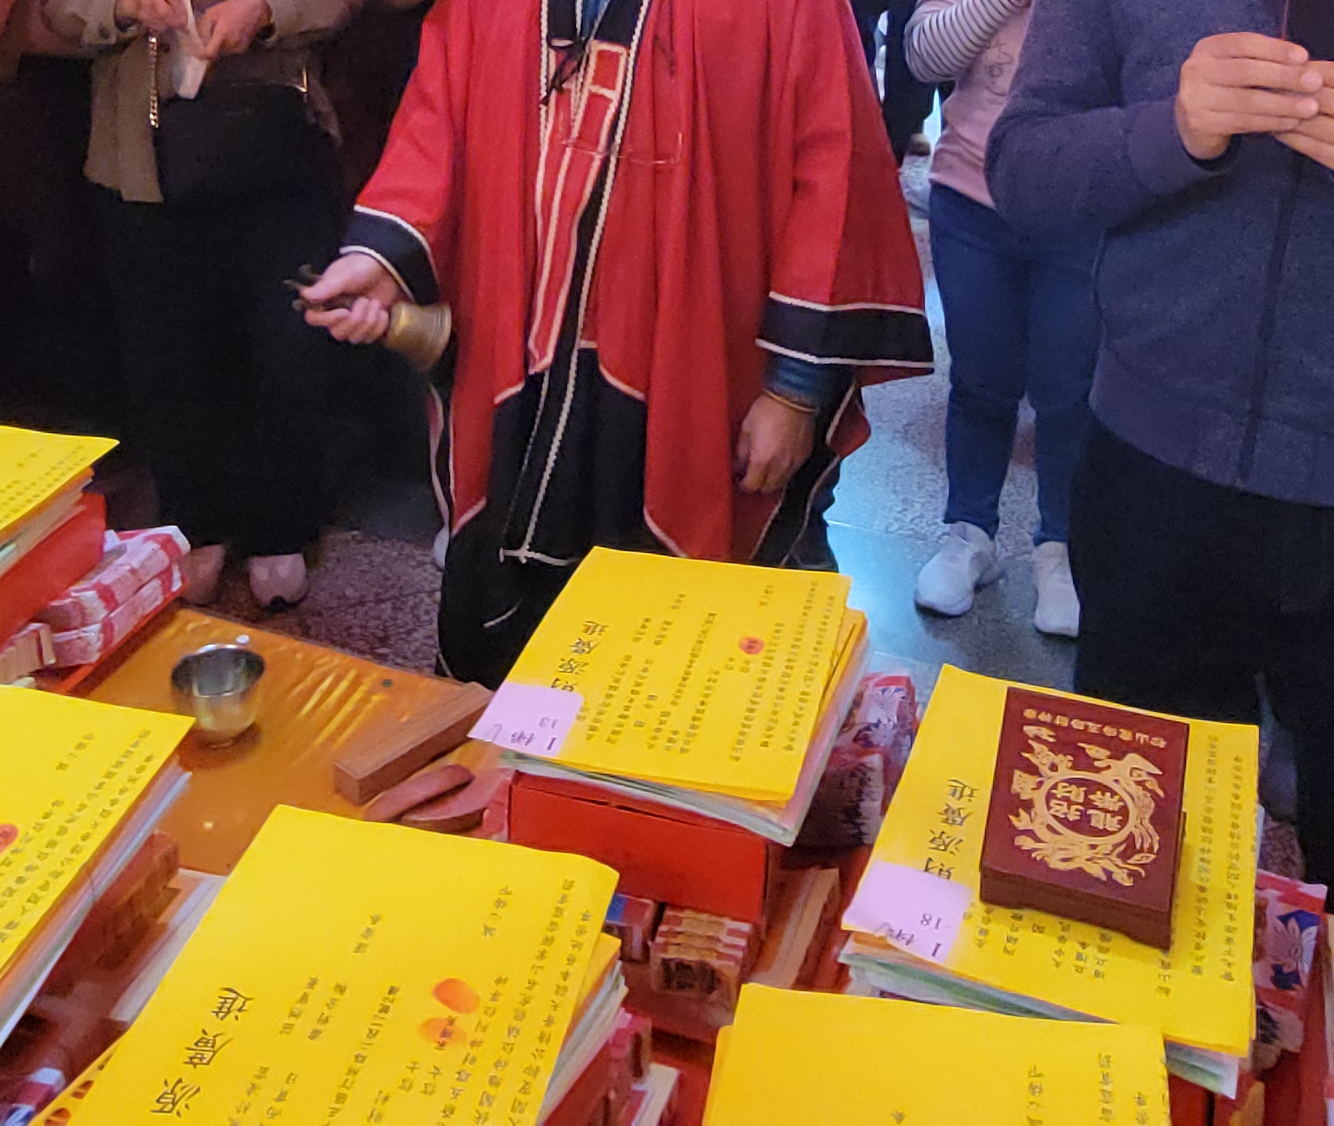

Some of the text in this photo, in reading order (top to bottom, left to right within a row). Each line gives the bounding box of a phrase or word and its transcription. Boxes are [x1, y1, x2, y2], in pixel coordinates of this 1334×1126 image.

[545, 620, 609, 691] 財源廣進
[917, 778, 978, 877] 財源廣進
[144, 986, 257, 1117] 源廣進
